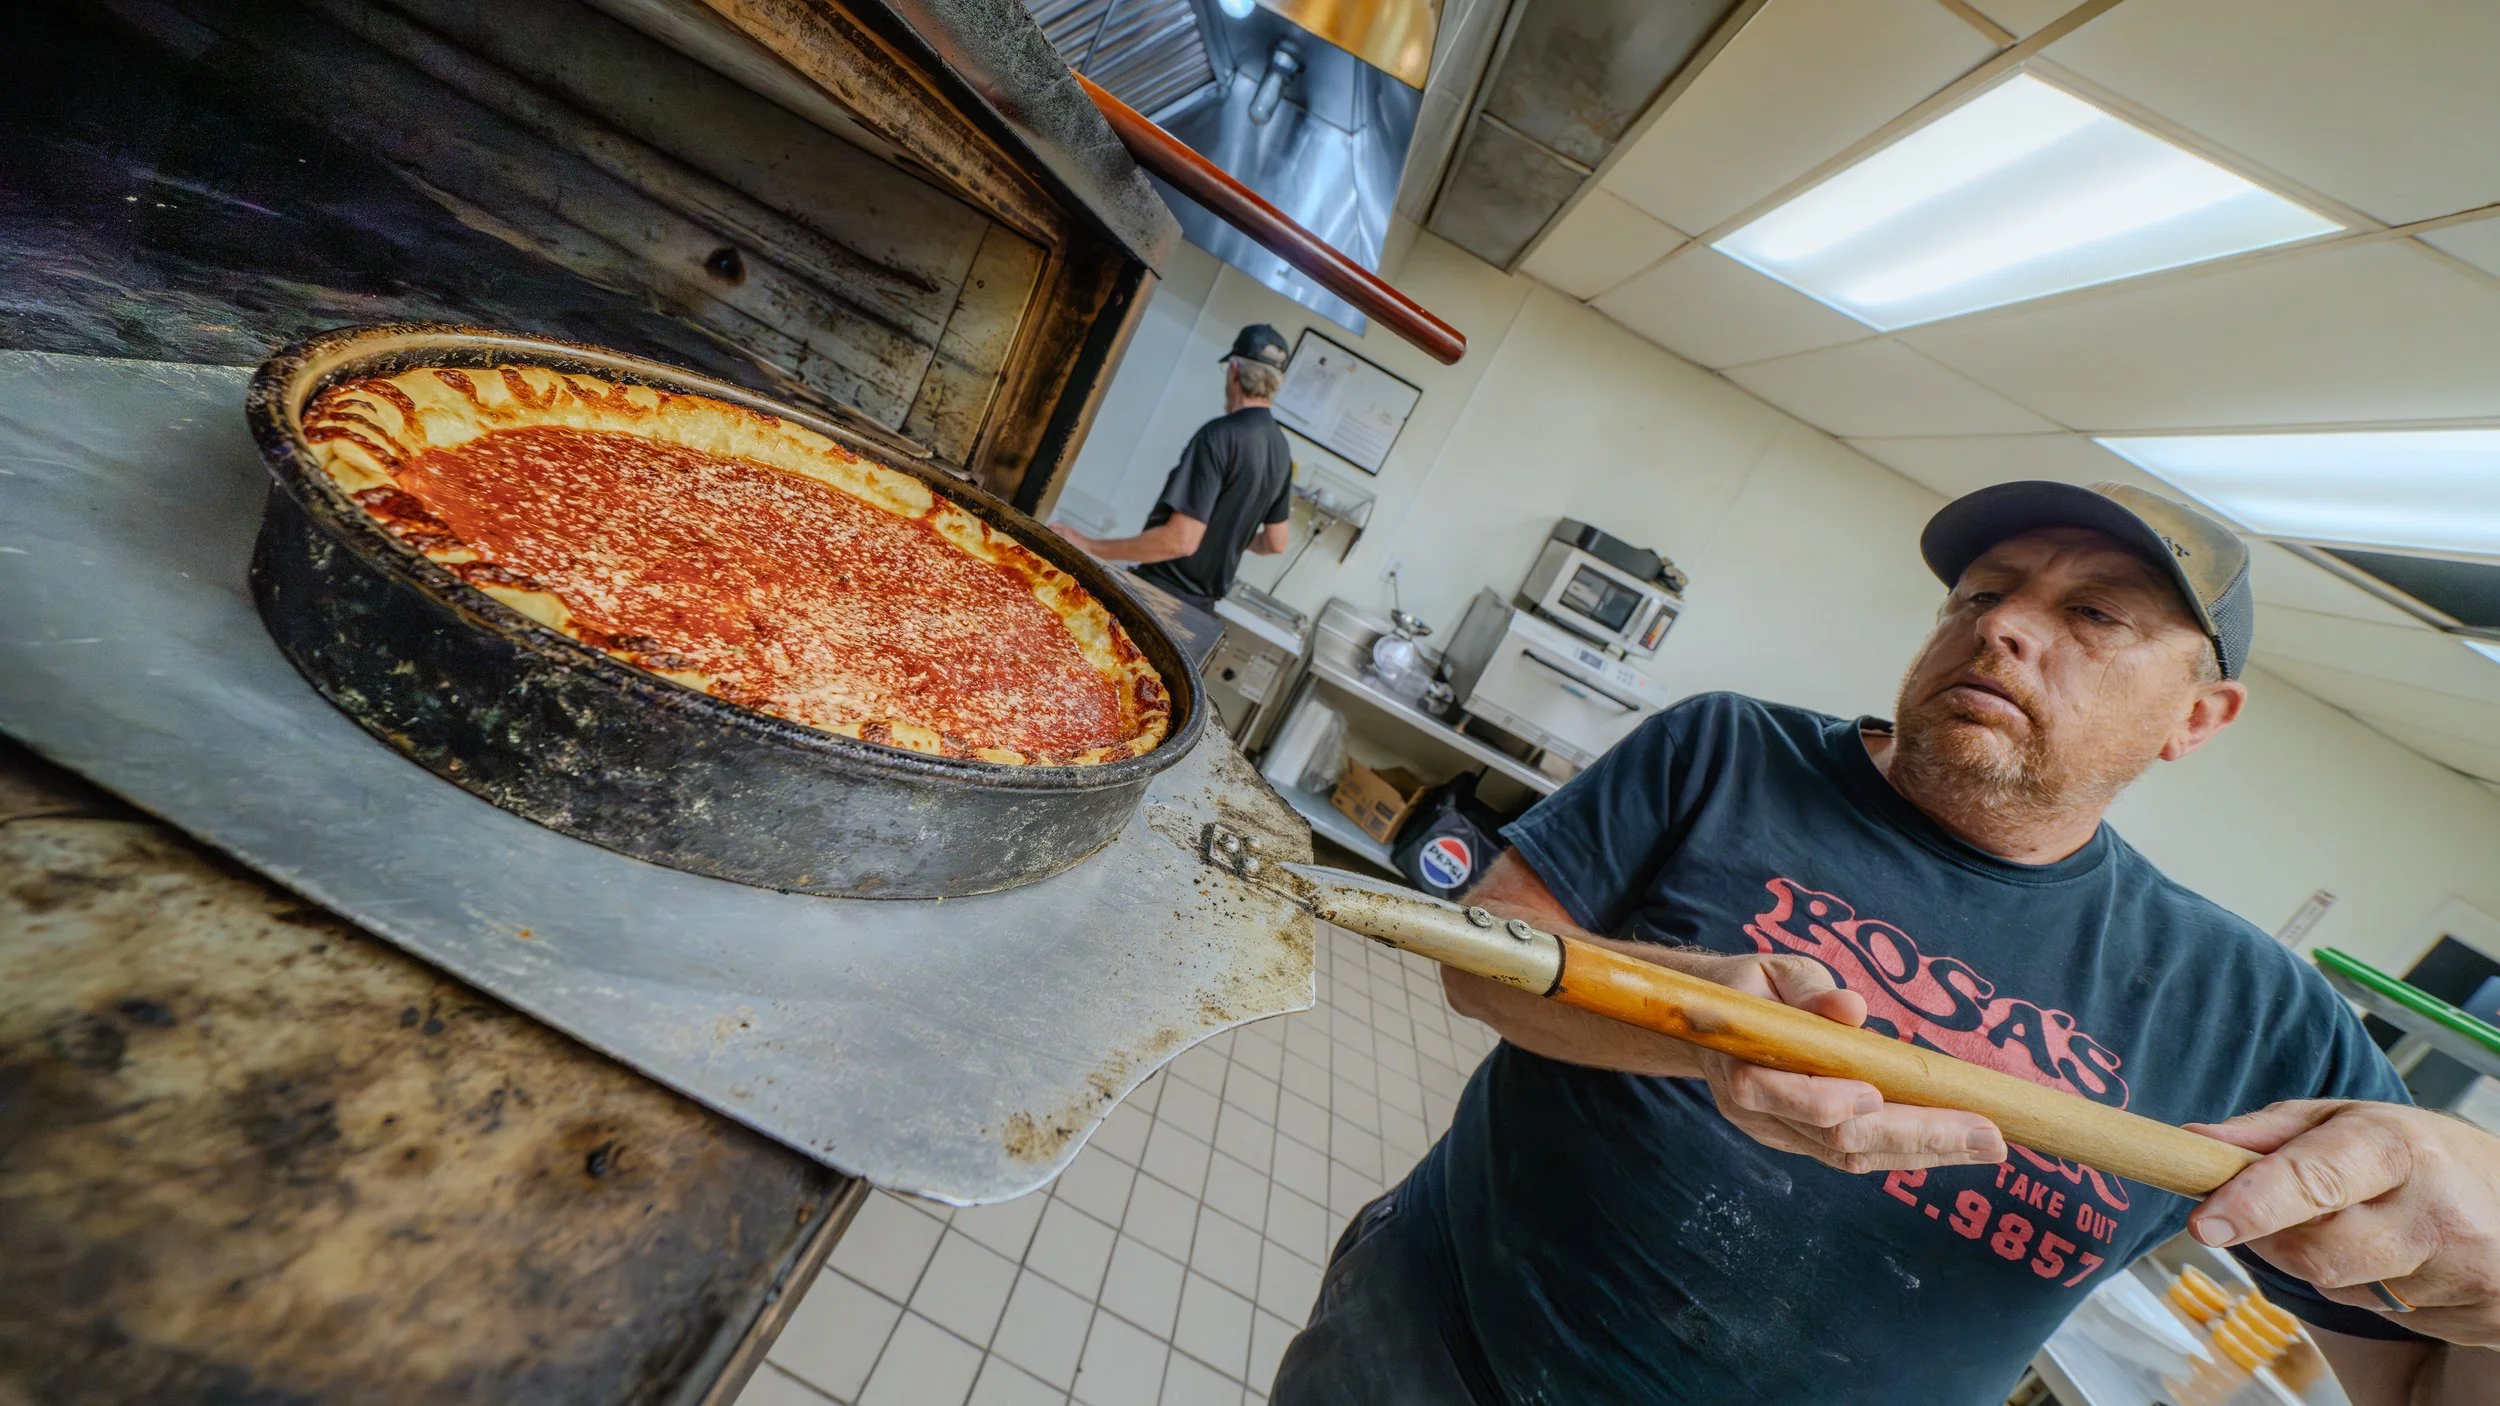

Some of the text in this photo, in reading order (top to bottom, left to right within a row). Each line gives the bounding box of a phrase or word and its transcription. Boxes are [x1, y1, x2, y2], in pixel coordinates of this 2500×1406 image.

[1428, 845, 1464, 880] PEPSI
[1756, 878, 2129, 1109] ROSA'S
[1996, 1162, 2066, 1219] TAKE
[2075, 1203, 2118, 1244] OUT
